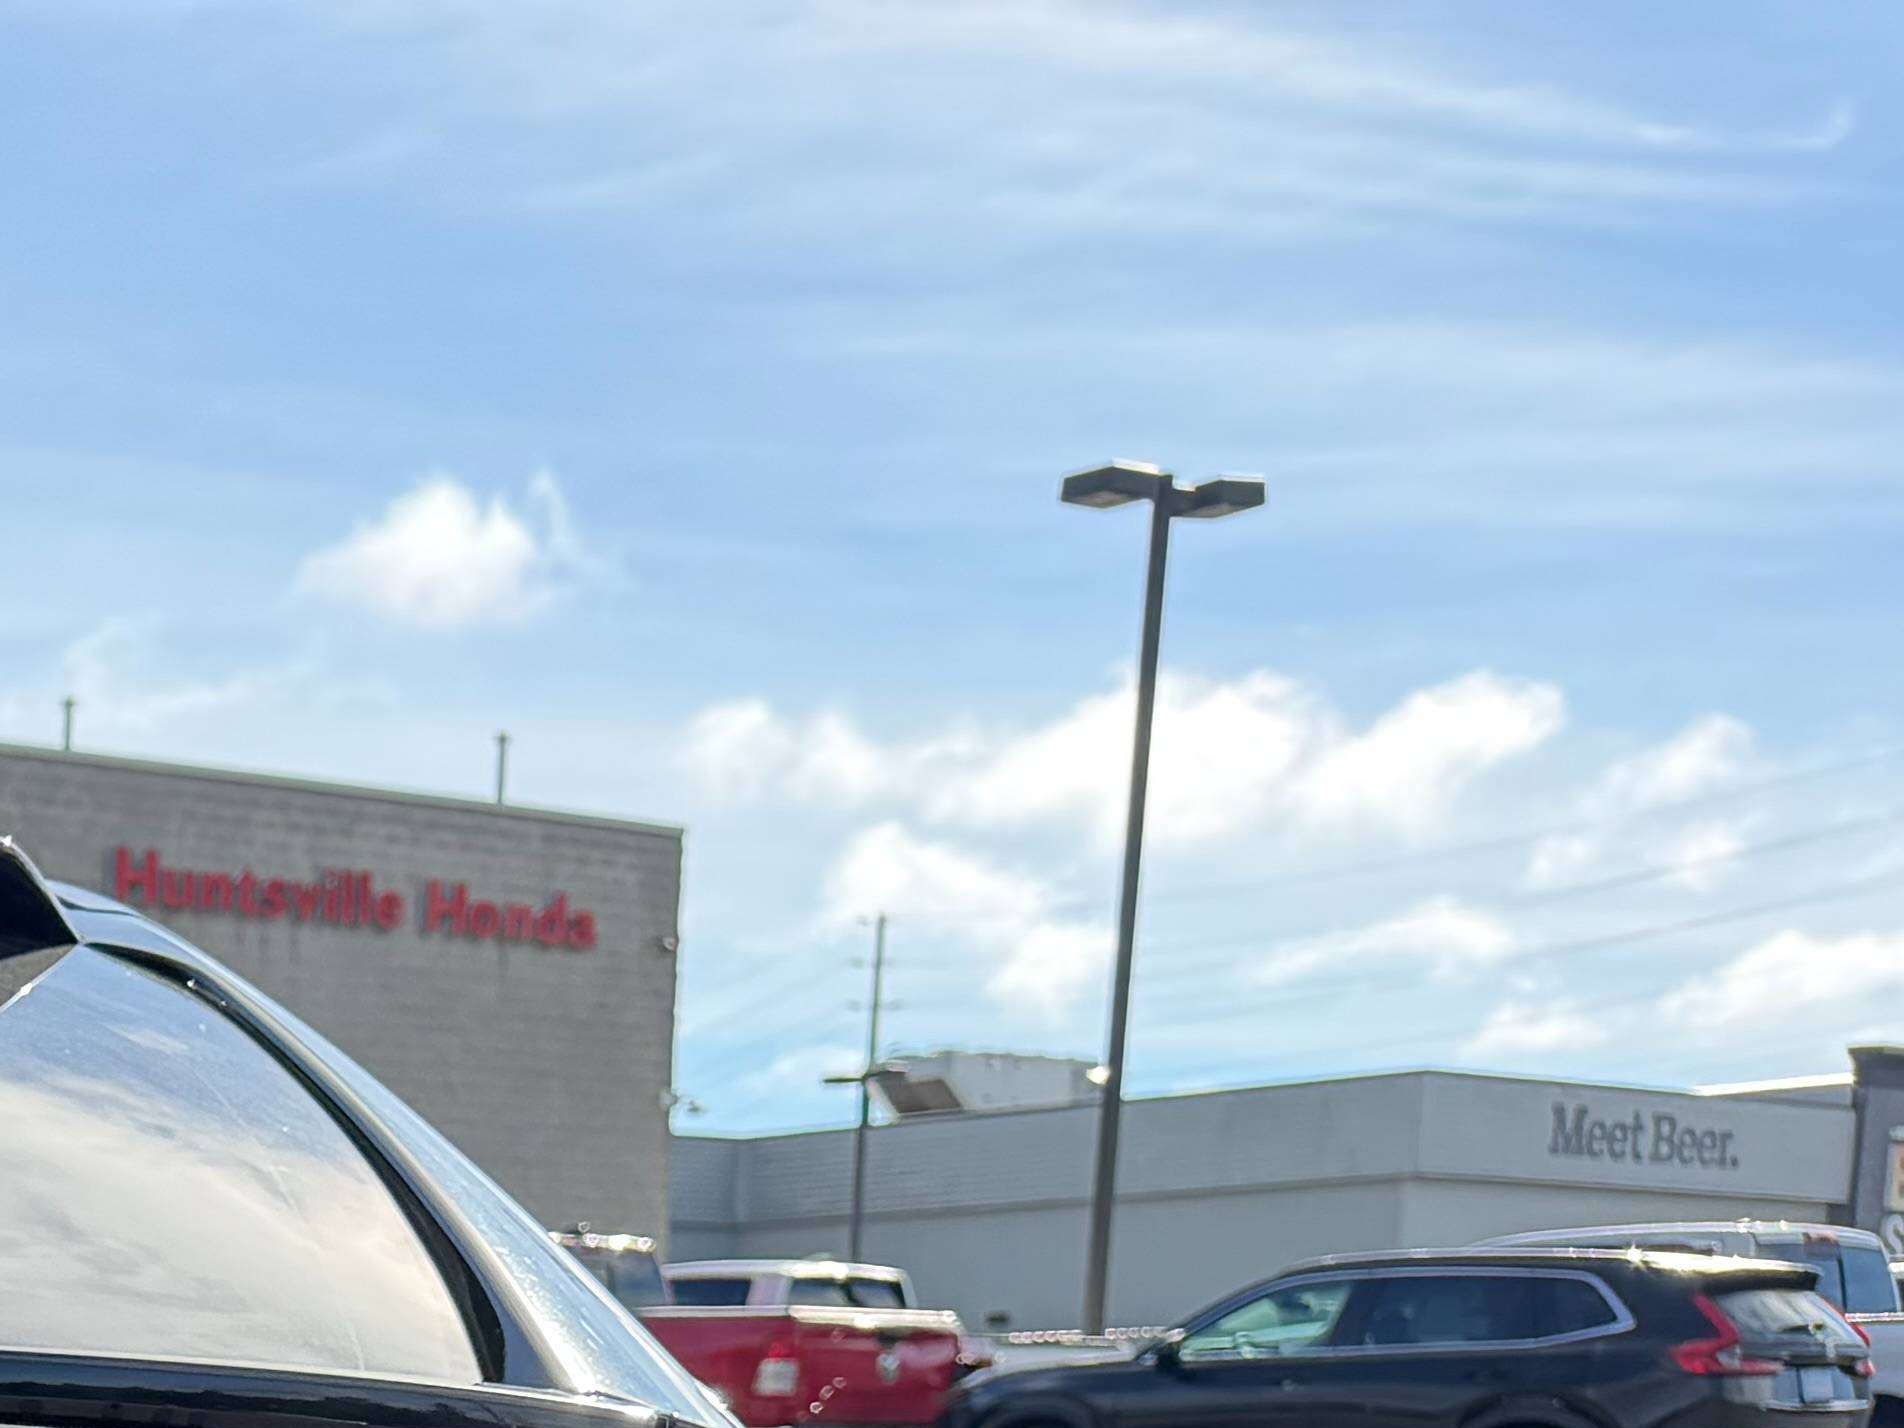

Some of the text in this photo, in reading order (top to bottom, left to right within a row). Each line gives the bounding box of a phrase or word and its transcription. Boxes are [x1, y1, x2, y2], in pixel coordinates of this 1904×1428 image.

[114, 846, 599, 950] Huntsville Honda
[1548, 1101, 1739, 1170] Meet Beer.
